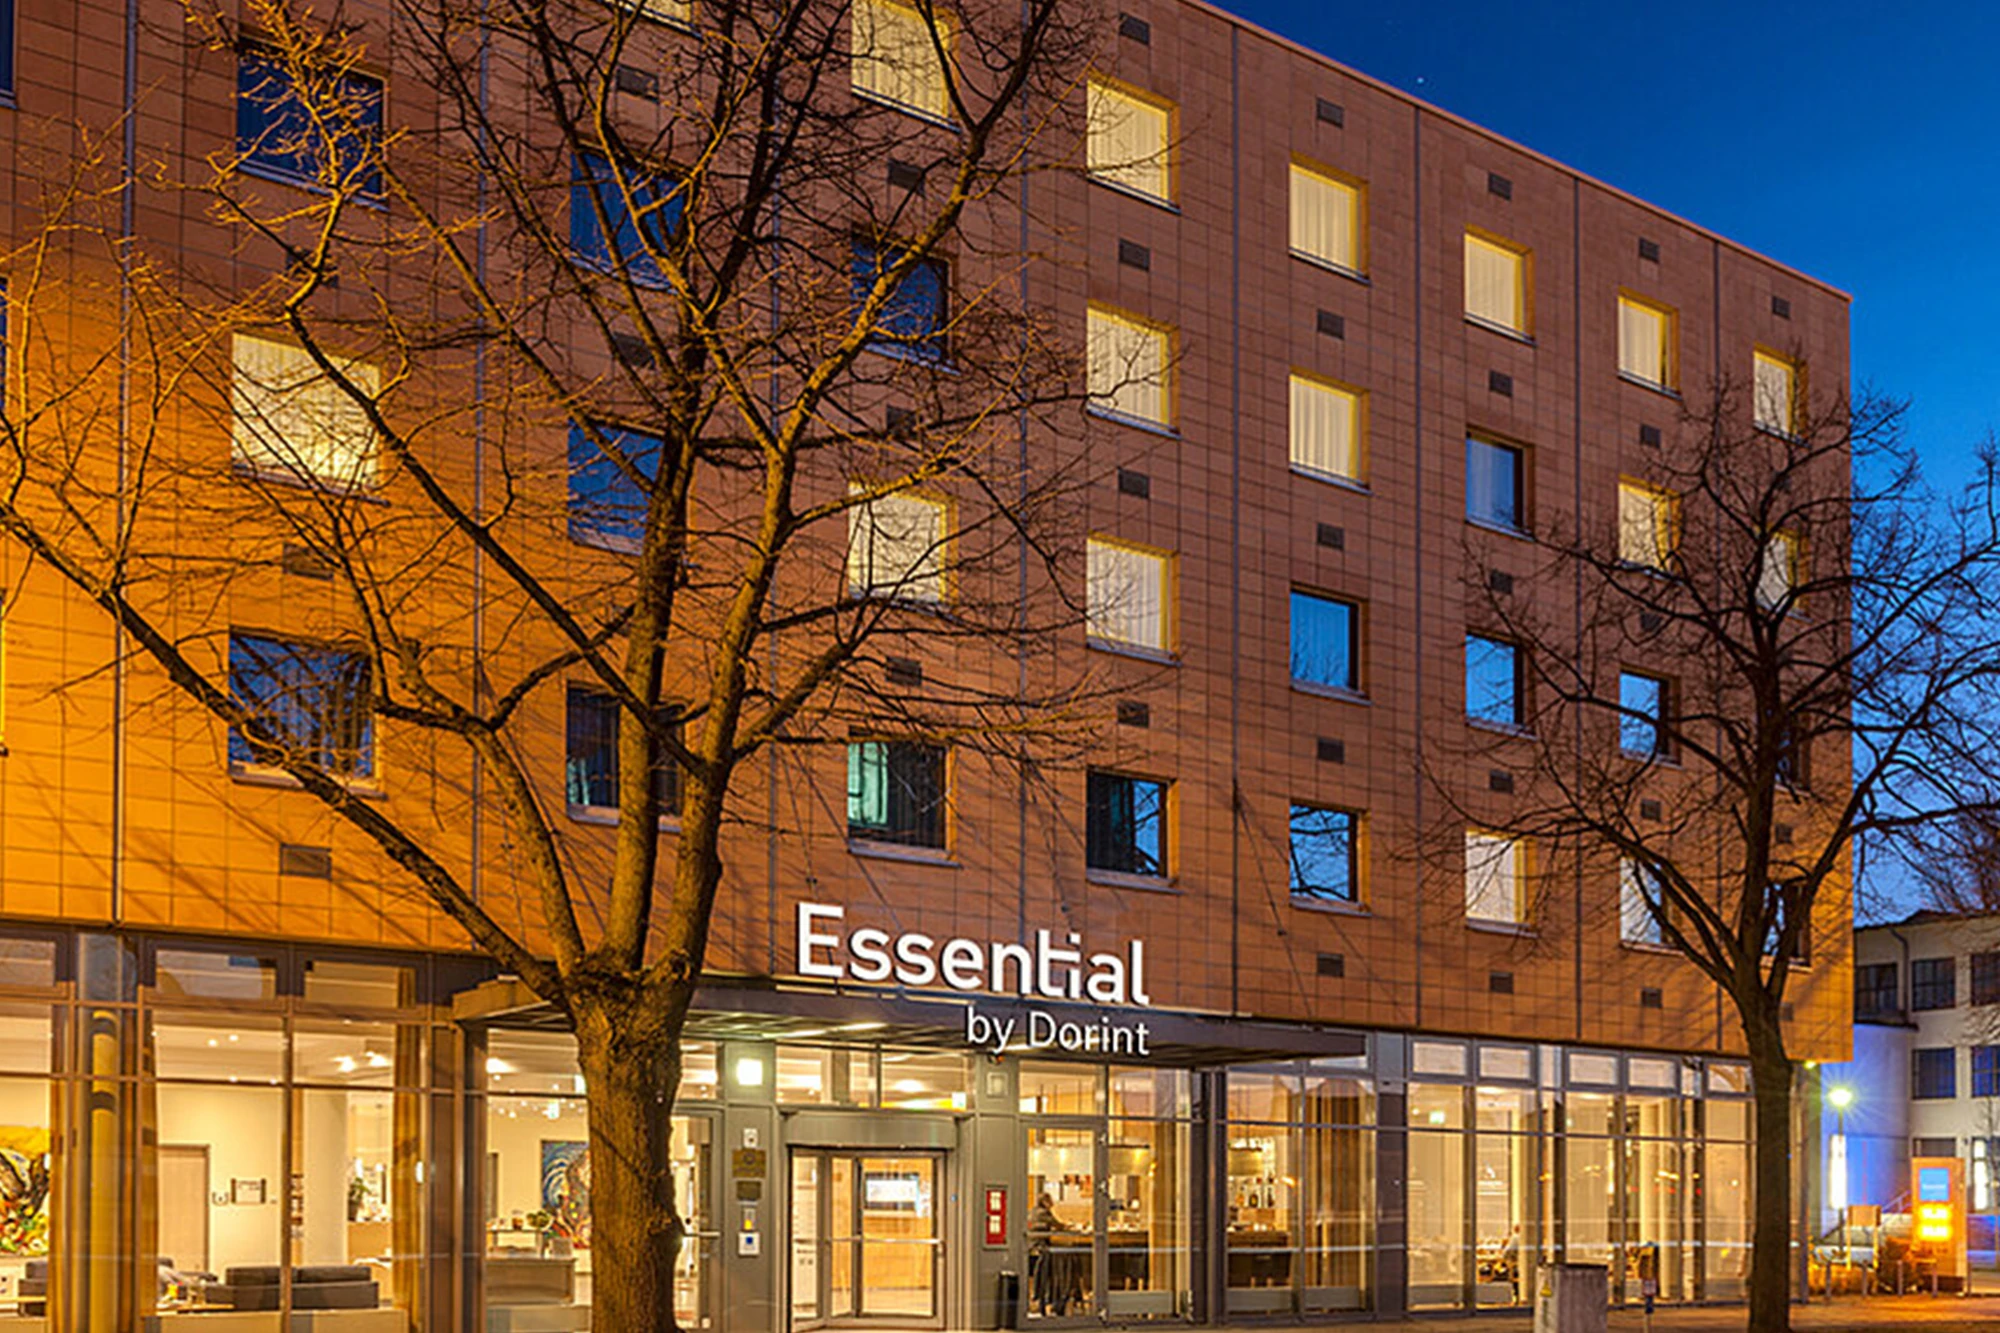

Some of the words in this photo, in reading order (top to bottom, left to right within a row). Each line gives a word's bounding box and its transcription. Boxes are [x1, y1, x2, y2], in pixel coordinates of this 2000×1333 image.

[797, 902, 1150, 1005] Essential
[966, 1005, 1014, 1053] by
[1029, 1010, 1150, 1055] Dorint
